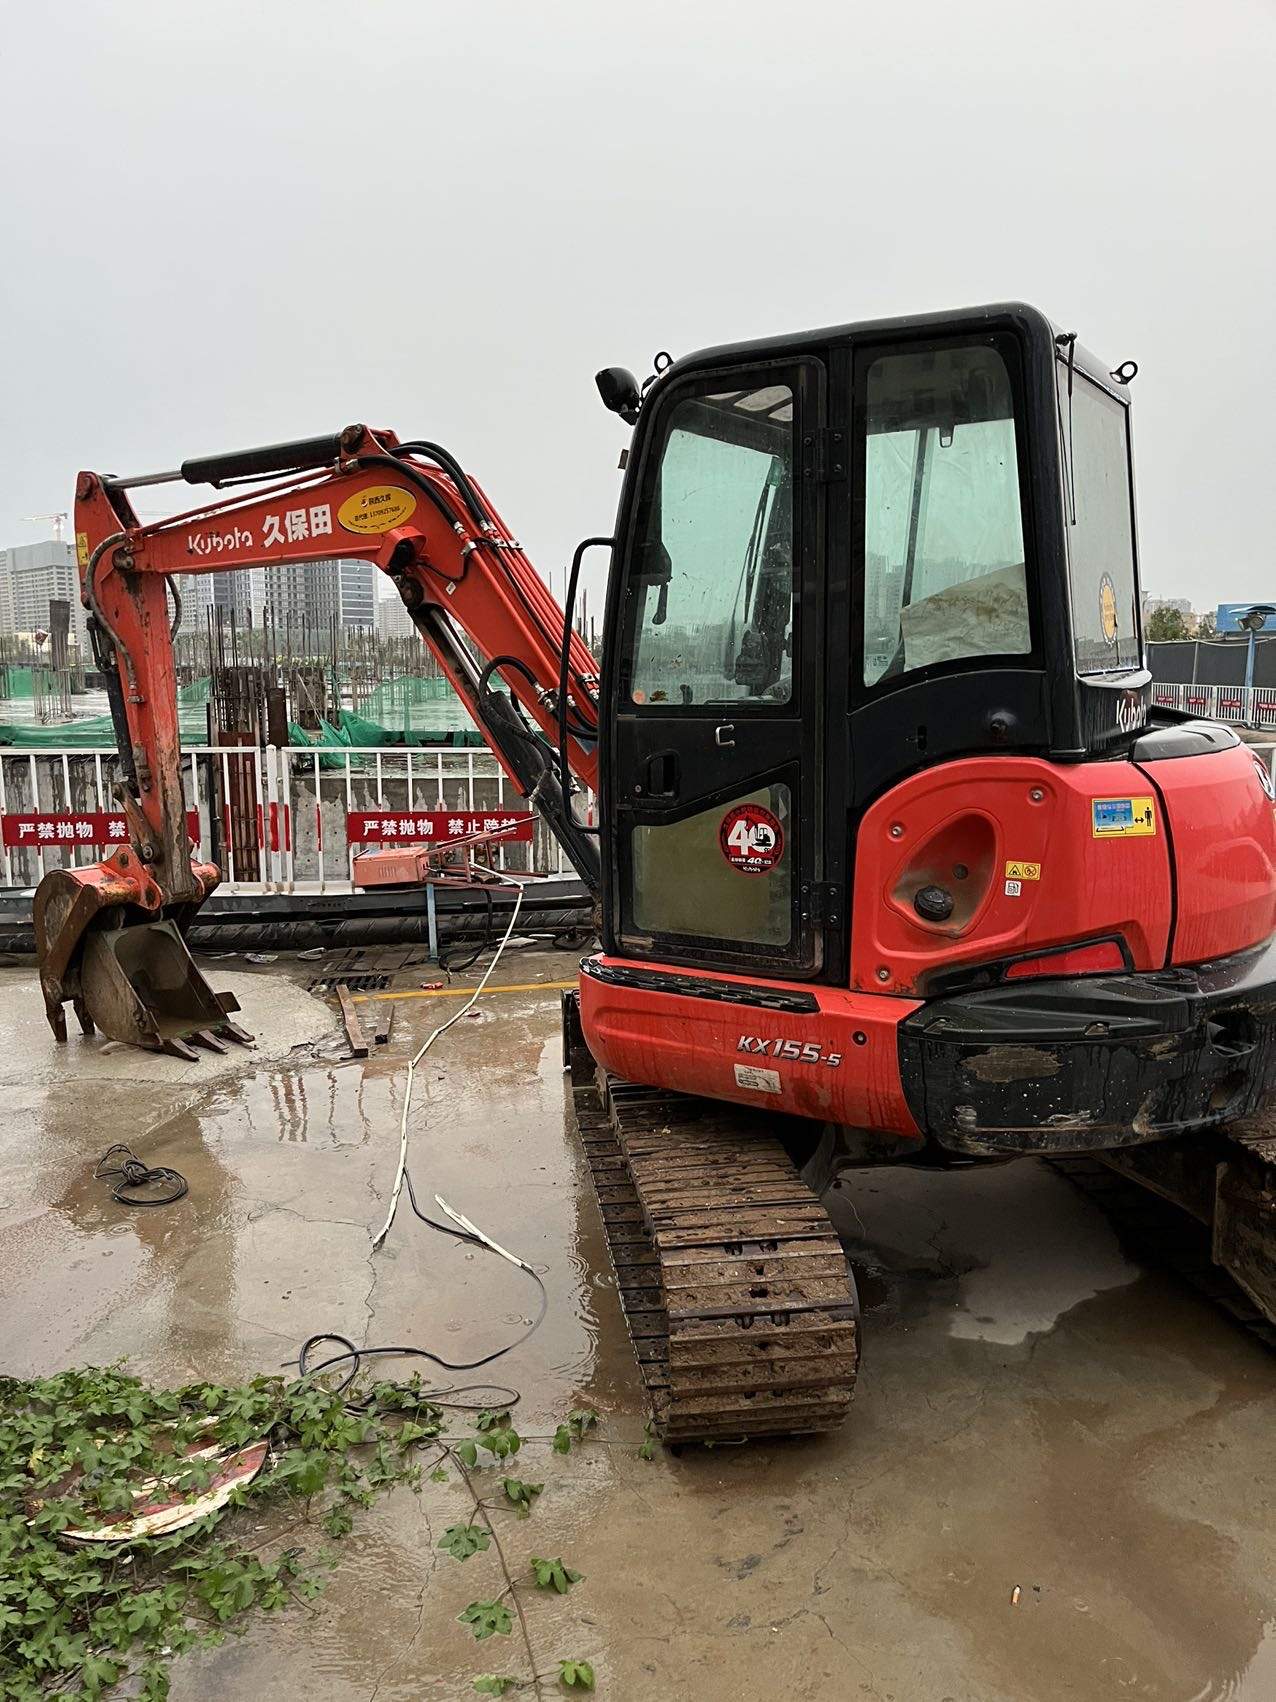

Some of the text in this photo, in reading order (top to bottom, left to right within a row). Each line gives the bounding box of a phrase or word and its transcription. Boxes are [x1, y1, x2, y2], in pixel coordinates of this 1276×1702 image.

[188, 526, 253, 555] Kubota
[261, 503, 333, 549] 久保田
[1116, 695, 1147, 733] Kubota
[18, 821, 94, 839] 严禁抛物
[363, 819, 434, 836] 严禁抛物
[737, 1035, 842, 1068] KX155-5
